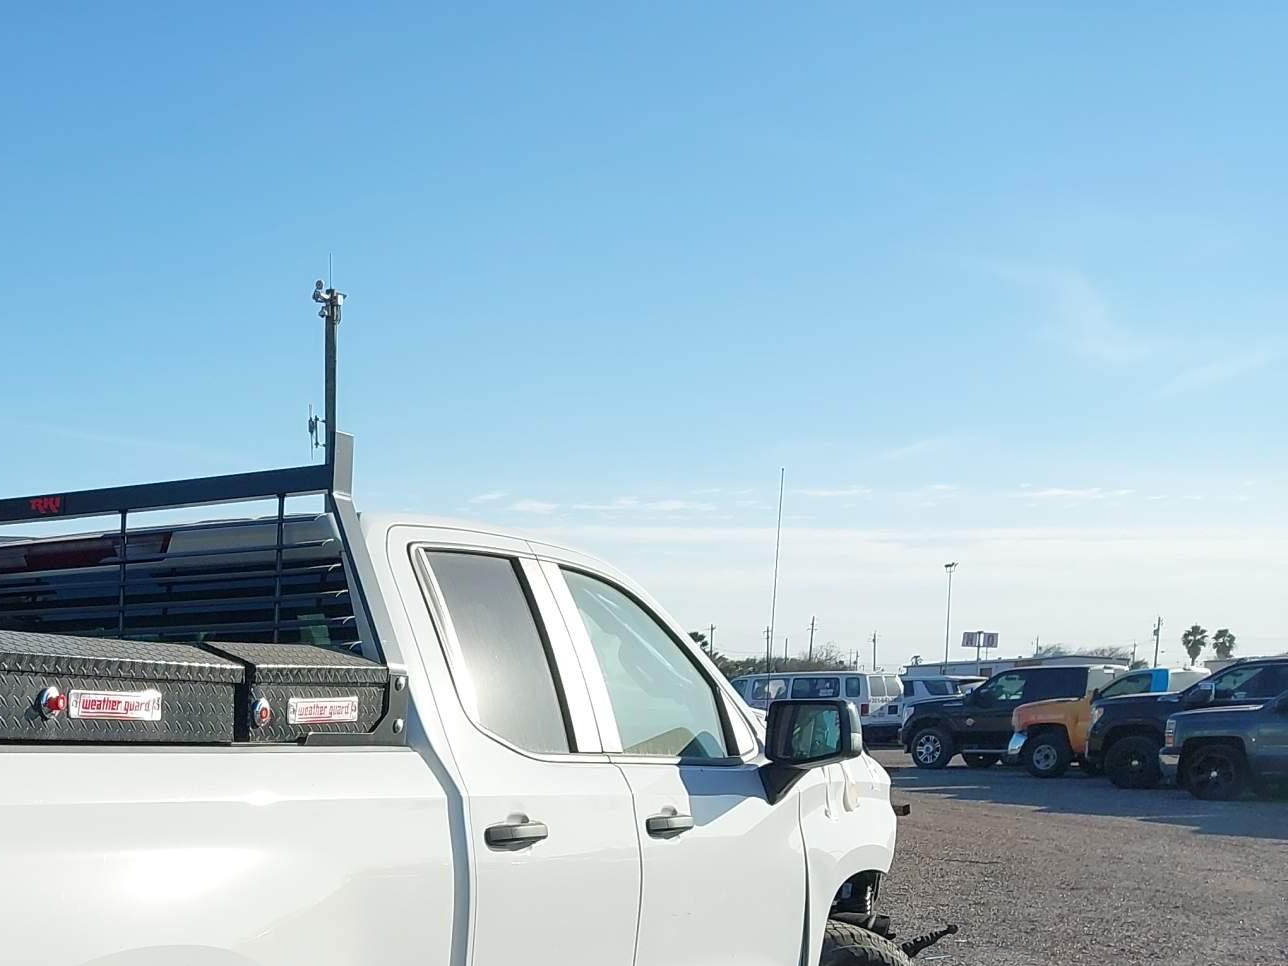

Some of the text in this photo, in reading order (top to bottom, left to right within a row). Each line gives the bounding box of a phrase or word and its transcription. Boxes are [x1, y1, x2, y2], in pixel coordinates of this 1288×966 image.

[81, 697, 151, 714] weather guard
[297, 703, 328, 716] weather
